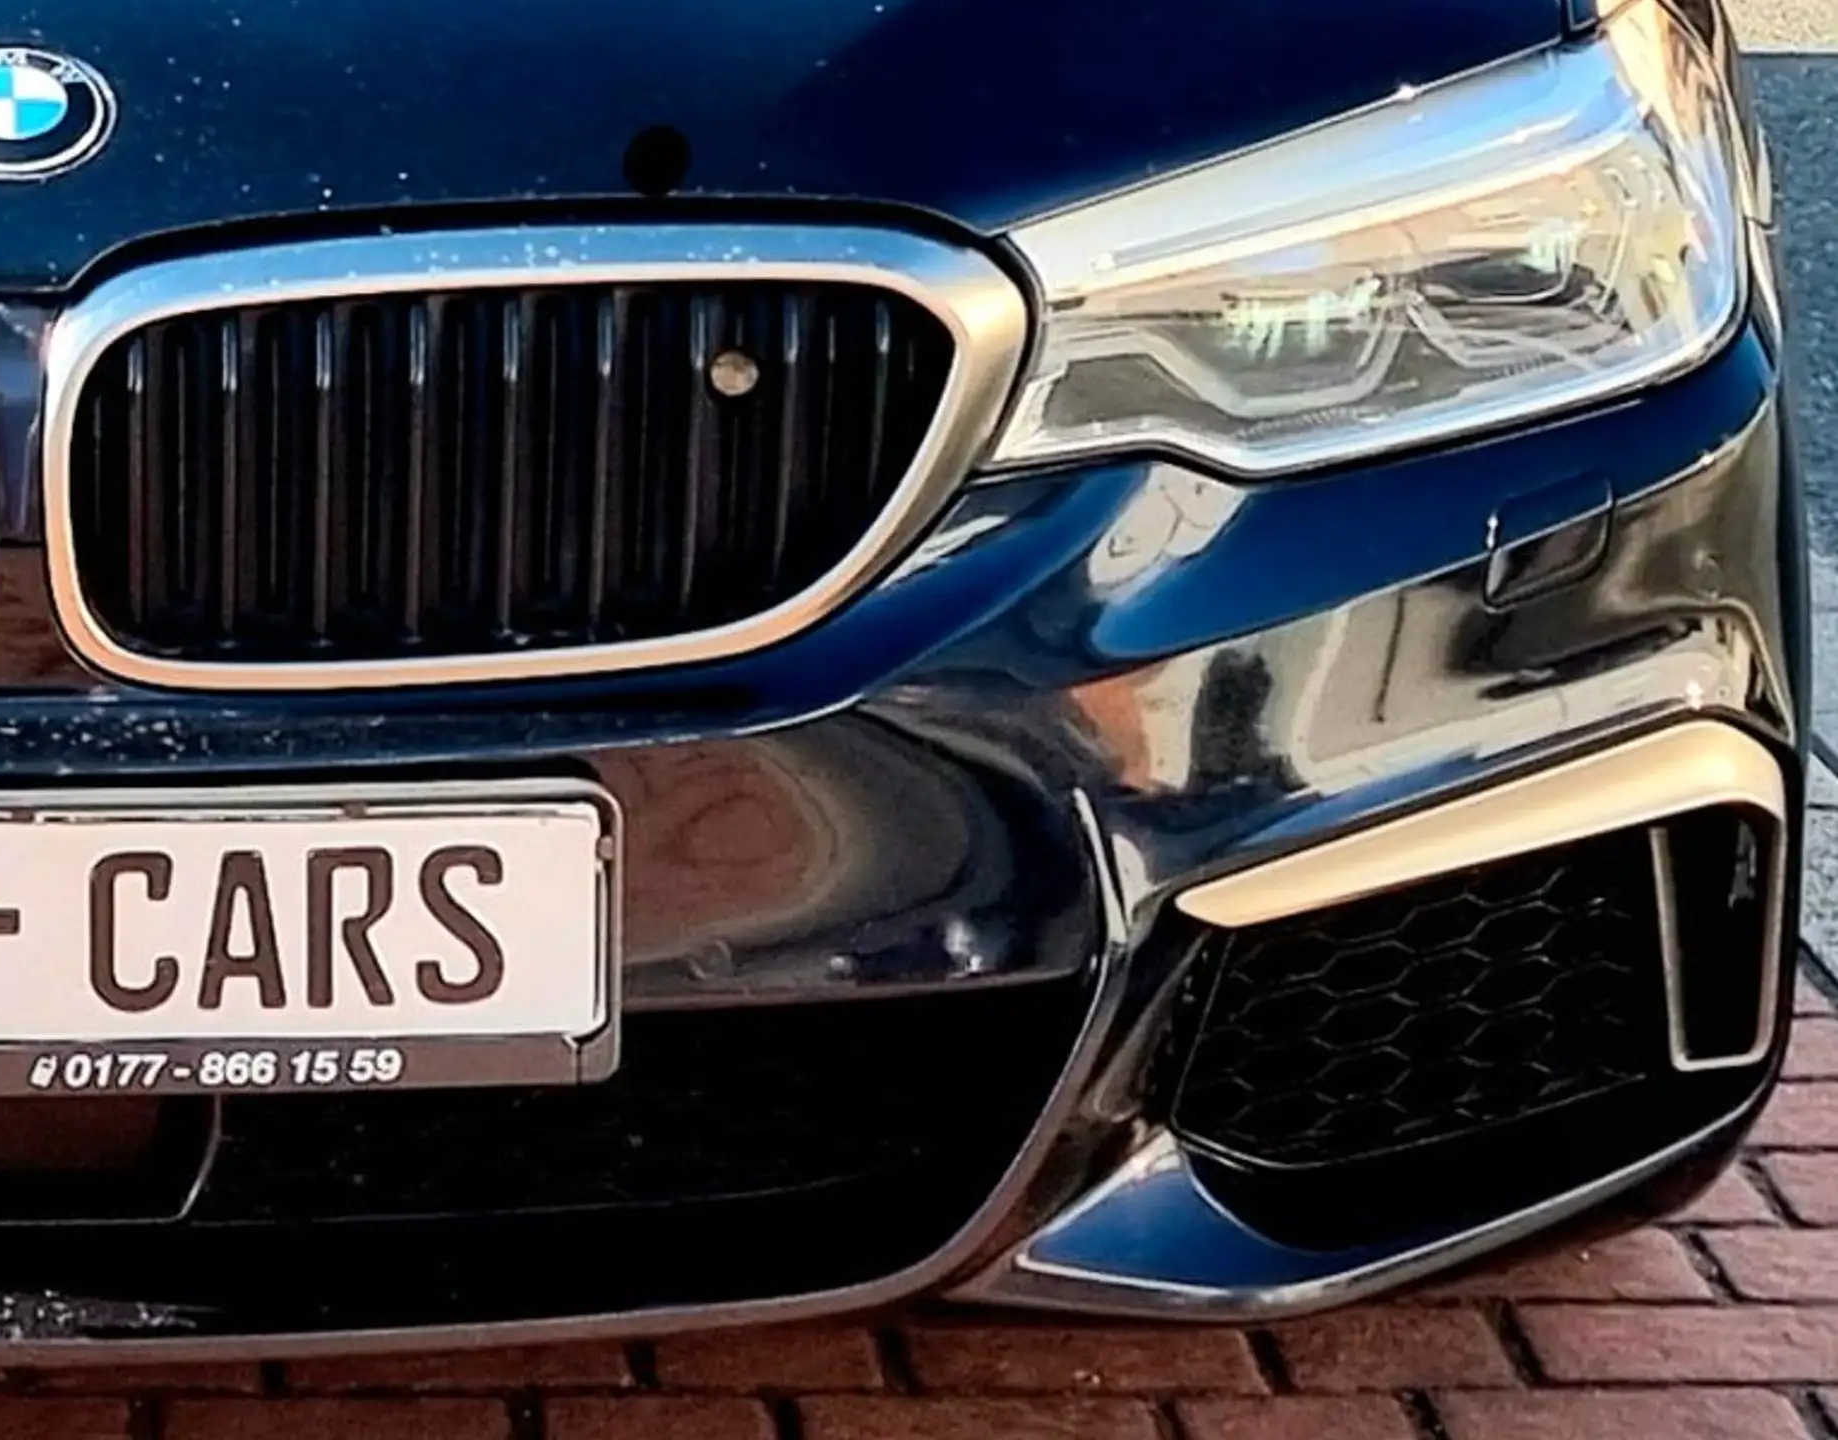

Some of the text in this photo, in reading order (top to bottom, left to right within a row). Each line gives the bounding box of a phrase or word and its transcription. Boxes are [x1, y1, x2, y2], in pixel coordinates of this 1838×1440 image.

[89, 845, 504, 1012] CARS
[290, 1050, 338, 1083] 15
[349, 1048, 402, 1082] 59
